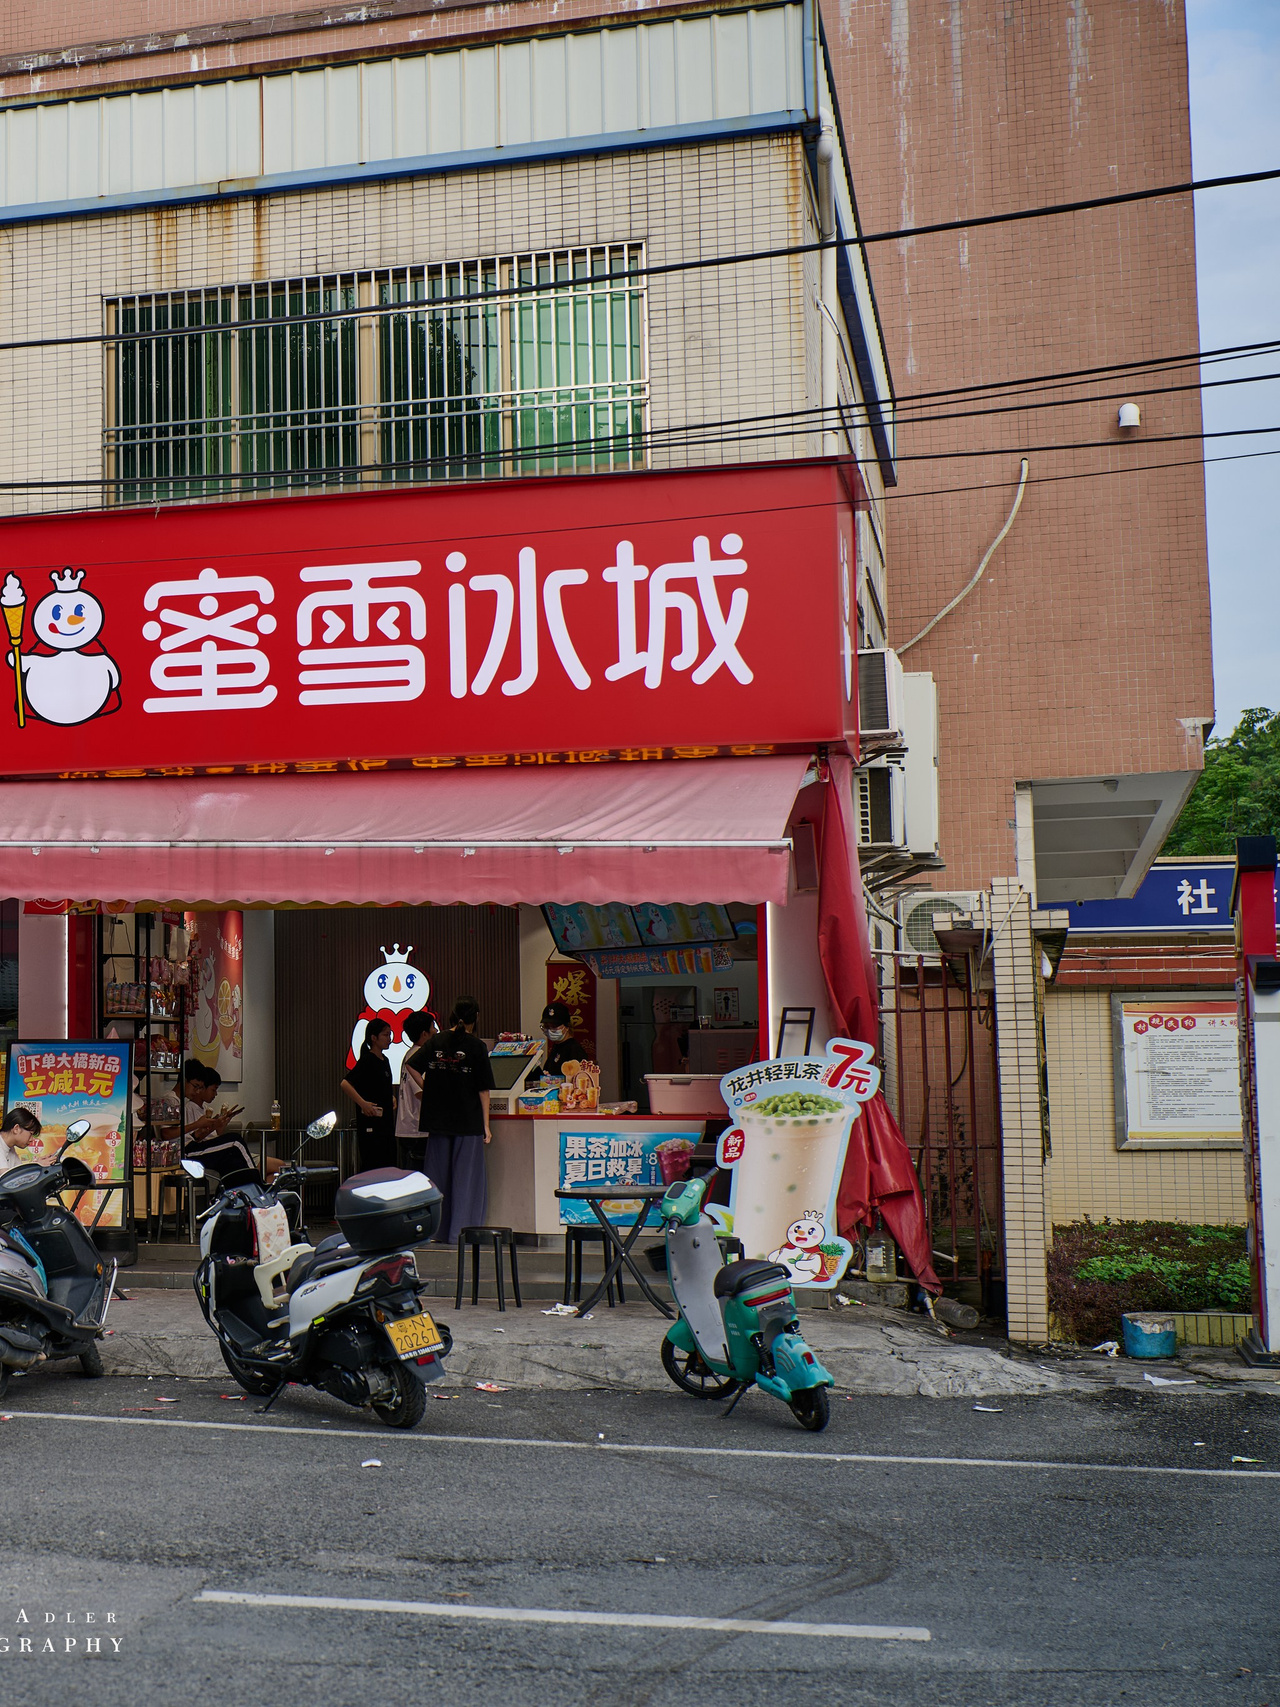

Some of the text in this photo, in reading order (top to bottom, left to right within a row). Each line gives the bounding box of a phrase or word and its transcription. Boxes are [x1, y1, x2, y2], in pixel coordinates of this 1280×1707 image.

[142, 533, 754, 714] 蜜雪冰城
[1177, 878, 1219, 915] 社
[26, 1052, 121, 1073] 下单大橘新品
[827, 1044, 871, 1095] 7元
[23, 1070, 114, 1097] 立减1元
[727, 1062, 823, 1096] 龙井轻乳茶
[564, 1136, 643, 1159] 果茶加冰
[649, 1152, 658, 1166] 8
[724, 1134, 742, 1159] 新品
[564, 1158, 643, 1184] 夏日救星
[396, 1328, 437, 1352] 2Q267
